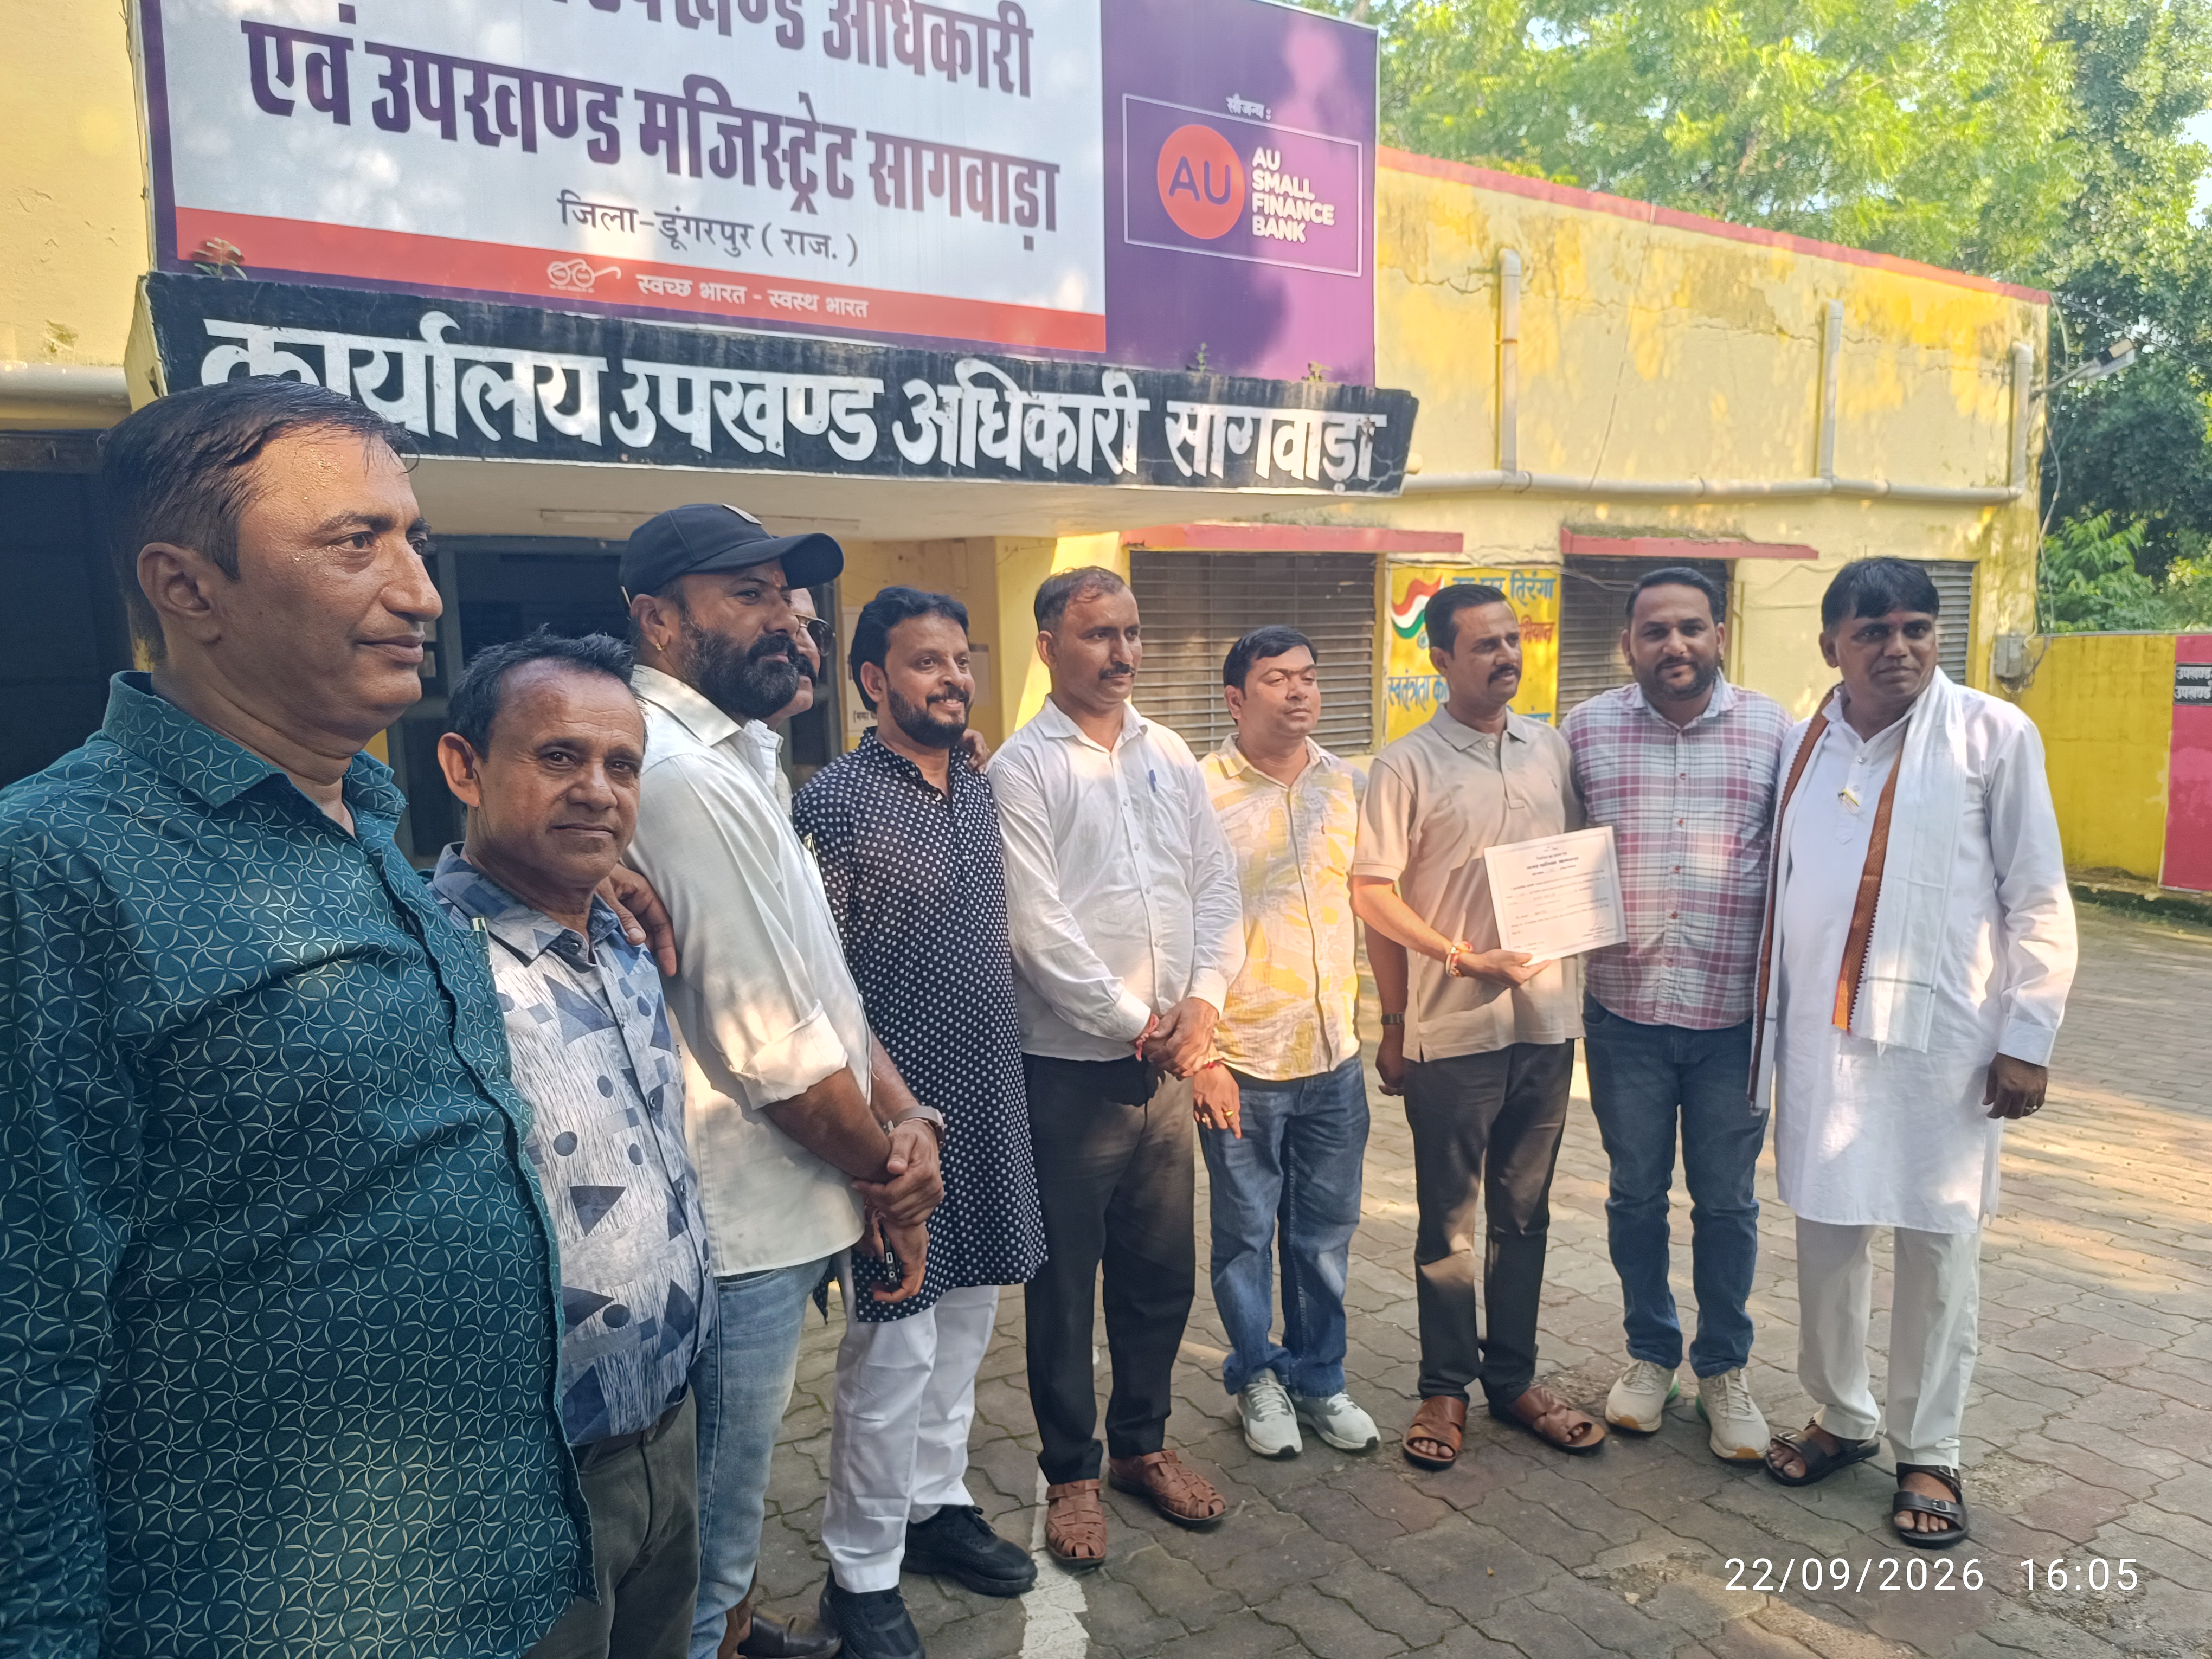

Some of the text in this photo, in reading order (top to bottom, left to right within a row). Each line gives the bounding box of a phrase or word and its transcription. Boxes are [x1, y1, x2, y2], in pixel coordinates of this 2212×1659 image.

[241, 3, 1060, 251] एवं उपखण्ड मजिस्ट्रेट सागवाड़ा
[1252, 147, 1281, 171] AU
[1168, 156, 1231, 206] AU
[1252, 169, 1316, 201] SMALL
[1252, 192, 1335, 226] FINANCE
[1252, 216, 1306, 243] BANK
[636, 273, 692, 298] स्वच्छ
[699, 281, 747, 305] भारत
[767, 288, 819, 313] स्वस्थ
[826, 295, 869, 319] भारत
[609, 358, 884, 461] उपखण्ड
[891, 358, 1151, 475] अधिकारी
[1164, 400, 1387, 492] सागवाड़ा
[1510, 569, 1557, 607] तिरंगा
[1519, 614, 1555, 644] भियान
